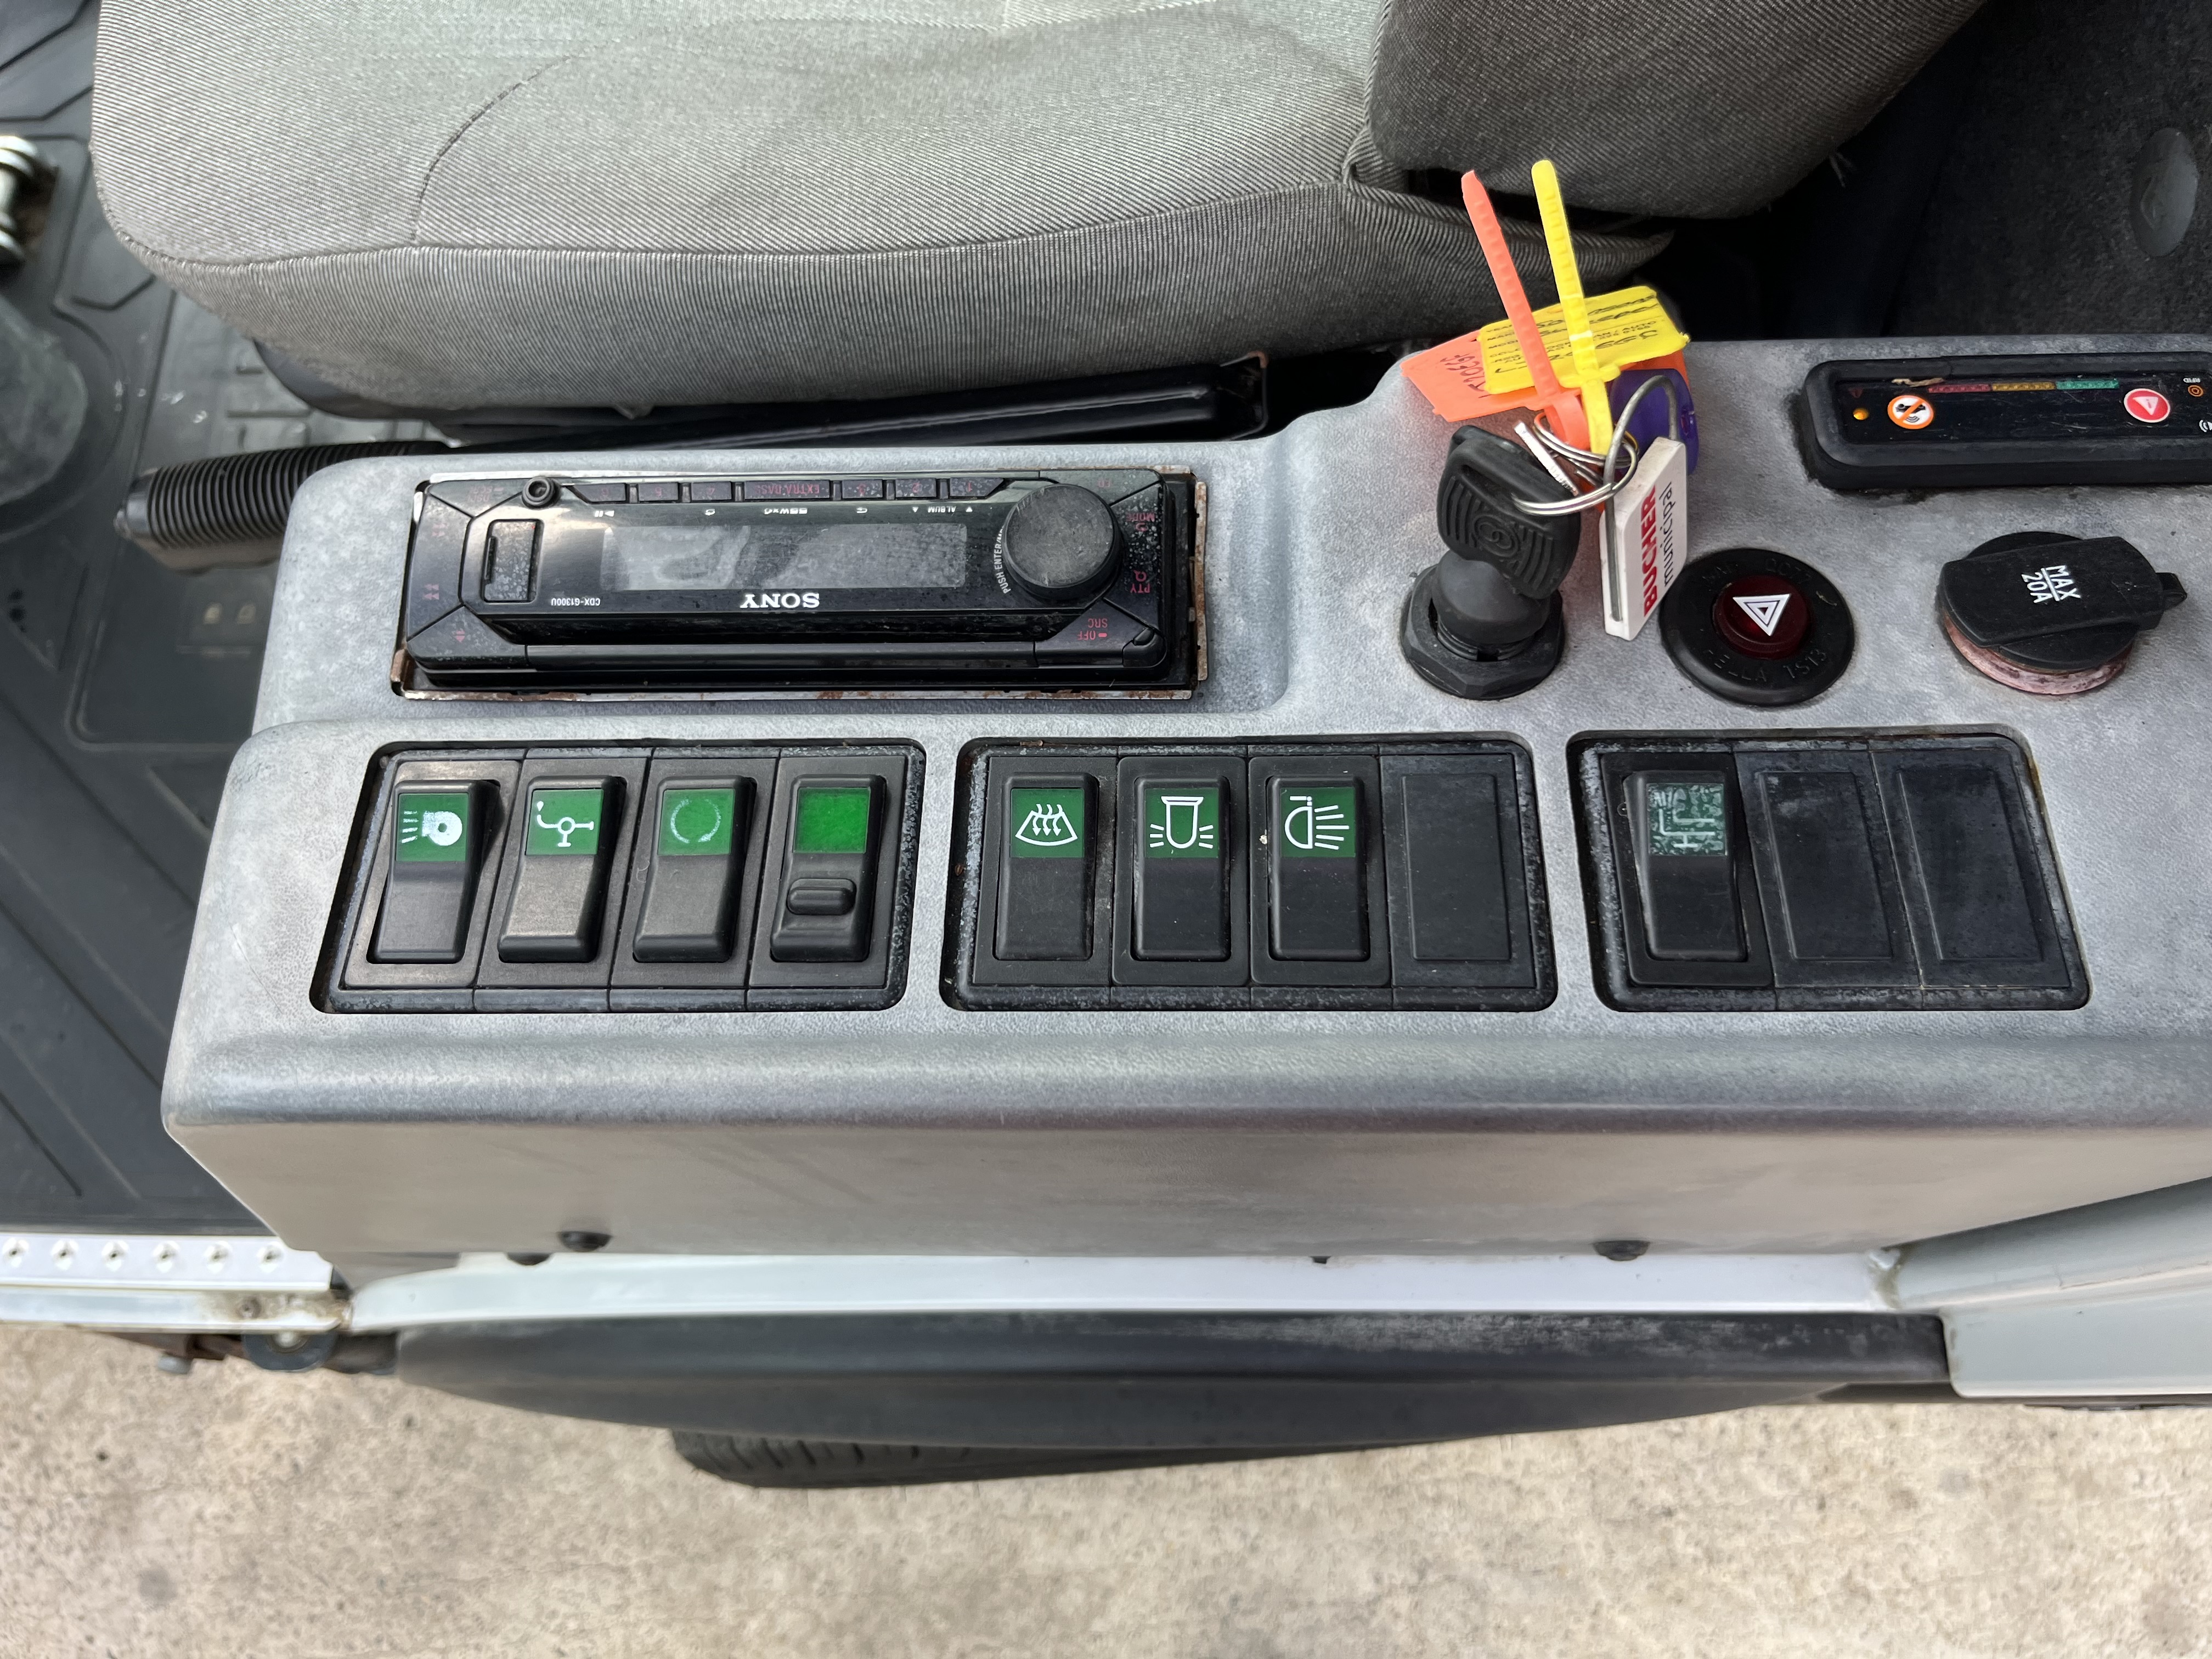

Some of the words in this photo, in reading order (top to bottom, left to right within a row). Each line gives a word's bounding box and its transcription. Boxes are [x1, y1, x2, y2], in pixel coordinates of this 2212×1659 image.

[1659, 482, 1675, 587] municipal
[1641, 484, 1657, 617] BUCHER
[996, 572, 1011, 594] PUSH
[1130, 583, 1150, 594] PTY
[2021, 571, 2053, 603] 20A
[2046, 565, 2081, 600] MAX
[550, 597, 601, 607] CDX-G1300U
[740, 592, 820, 608] SONY
[1087, 618, 1108, 628] SRC
[1076, 630, 1096, 640] OFF
